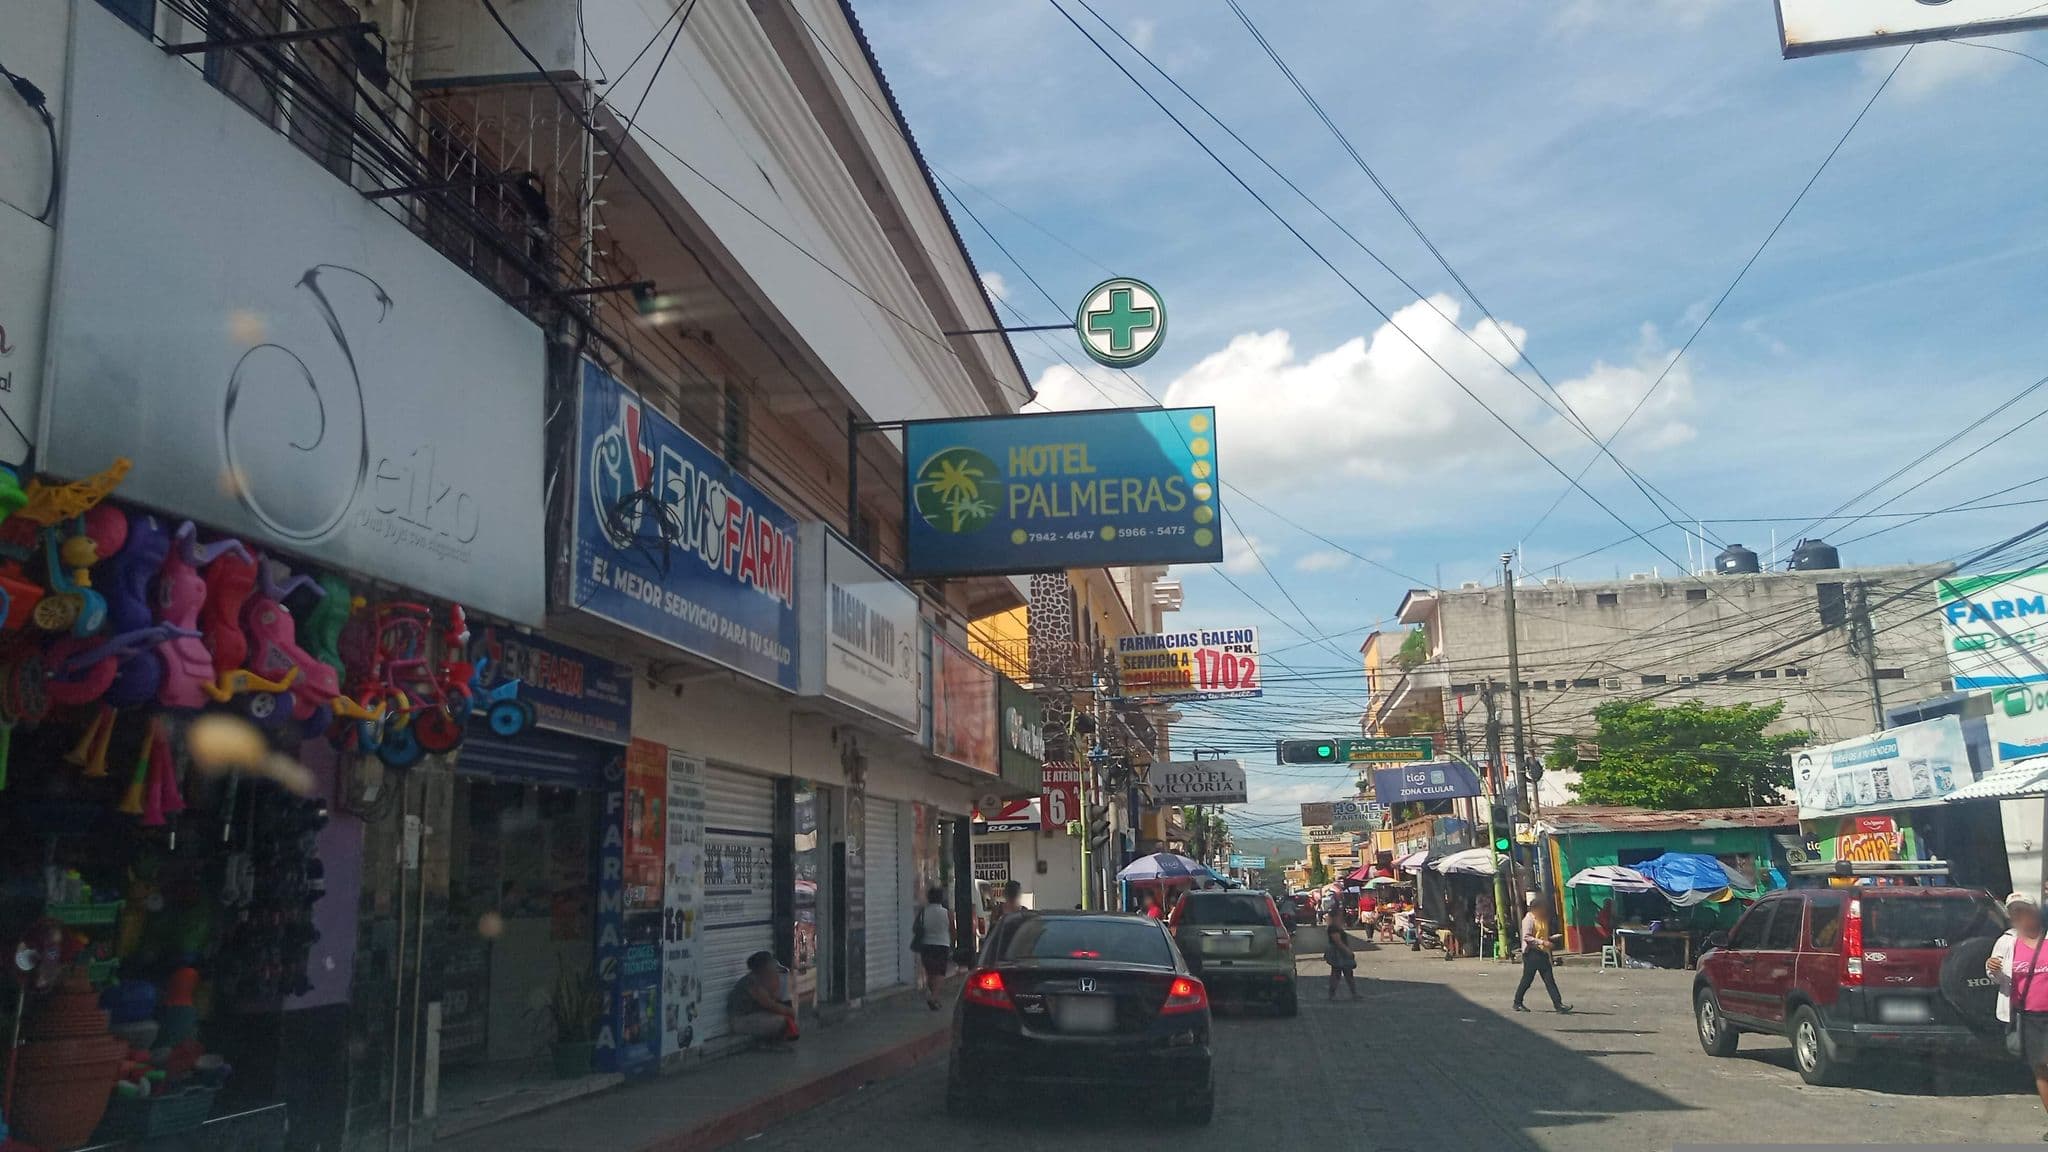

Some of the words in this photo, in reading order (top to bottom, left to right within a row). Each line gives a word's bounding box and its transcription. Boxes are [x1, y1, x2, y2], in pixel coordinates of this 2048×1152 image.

[1009, 443, 1096, 477] HOTEL
[1009, 475, 1186, 519] PALMERAS
[1029, 532, 1057, 542] 7942
[1067, 530, 1094, 540] 4647
[1118, 527, 1146, 537] 5966
[1157, 526, 1185, 536] 5475
[592, 556, 610, 587] EL
[614, 567, 662, 608] MEJOR
[664, 592, 718, 633] SERVICIO
[720, 617, 747, 647] PARA
[749, 631, 761, 653] TU
[762, 638, 790, 665] SALUD
[1945, 594, 2048, 627] FARM
[1120, 632, 1197, 652] FARMACIAS
[1202, 629, 1253, 646] GALENO
[1224, 645, 1256, 654] PBX.
[1124, 653, 1178, 669] SERVICIO
[1181, 652, 1189, 667] A
[1194, 648, 1256, 690] 1702
[1042, 770, 1051, 782] LE
[1165, 771, 1232, 784] HOTEL
[1155, 782, 1234, 793] VICTORIA
[1401, 787, 1421, 796] ZONA
[1422, 785, 1455, 794] CELULAR
[1050, 788, 1066, 825] 6
[1333, 801, 1391, 814] HOTEL
[1334, 812, 1381, 821] MARTINEZ
[974, 870, 1007, 880] GALENO
